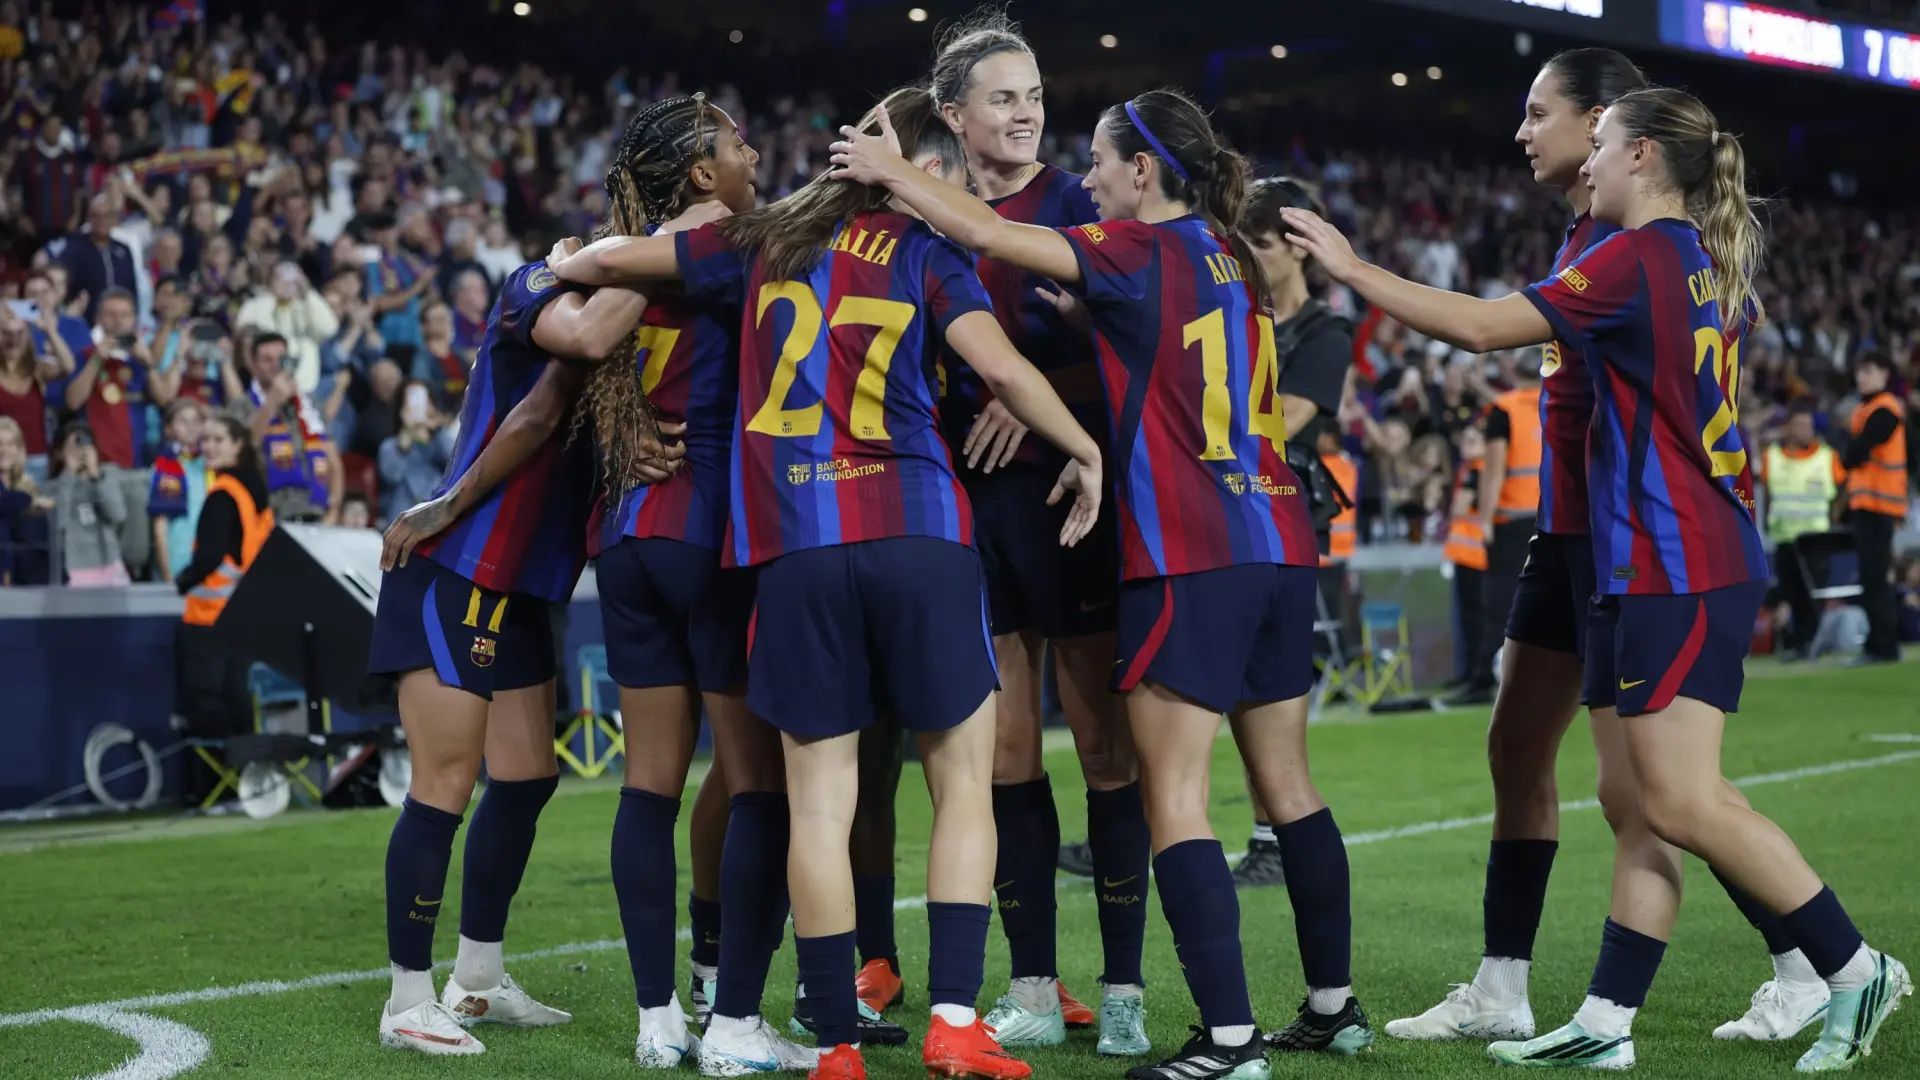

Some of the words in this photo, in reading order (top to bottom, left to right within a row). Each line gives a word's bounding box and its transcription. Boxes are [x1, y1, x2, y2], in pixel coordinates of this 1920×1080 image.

[827, 225, 898, 266] ALÍA
[745, 279, 917, 441] 27
[1182, 307, 1288, 464] 14
[1693, 326, 1748, 478] 21
[815, 458, 851, 473] BARÇA
[816, 463, 885, 481] FOUNDATION
[1103, 893, 1140, 907] BARÇA
